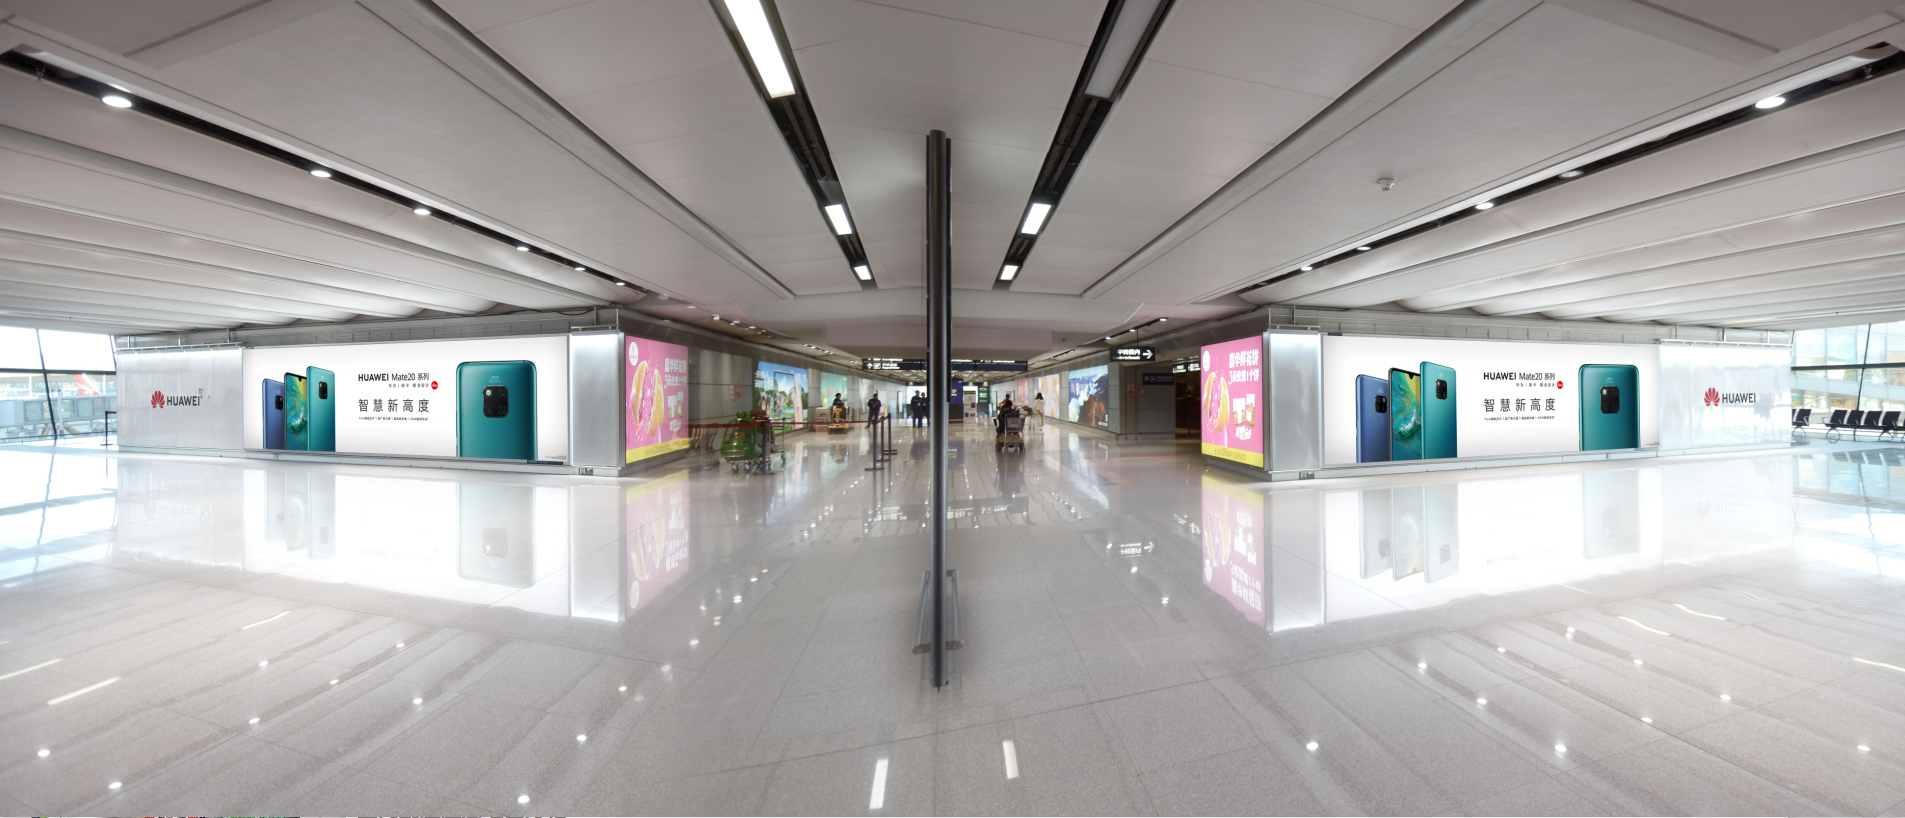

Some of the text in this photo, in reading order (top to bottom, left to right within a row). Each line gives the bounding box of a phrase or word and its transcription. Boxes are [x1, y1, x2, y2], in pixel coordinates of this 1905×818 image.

[358, 372, 430, 382] HUAWEI Mate20 系列
[1483, 372, 1556, 381] HUAWEI Mate20 系列
[166, 395, 201, 407] HUAWEI
[1721, 392, 1757, 404] HUAWEI
[358, 398, 430, 413] 智慧新高度
[1483, 398, 1556, 413] 智慧新高度
